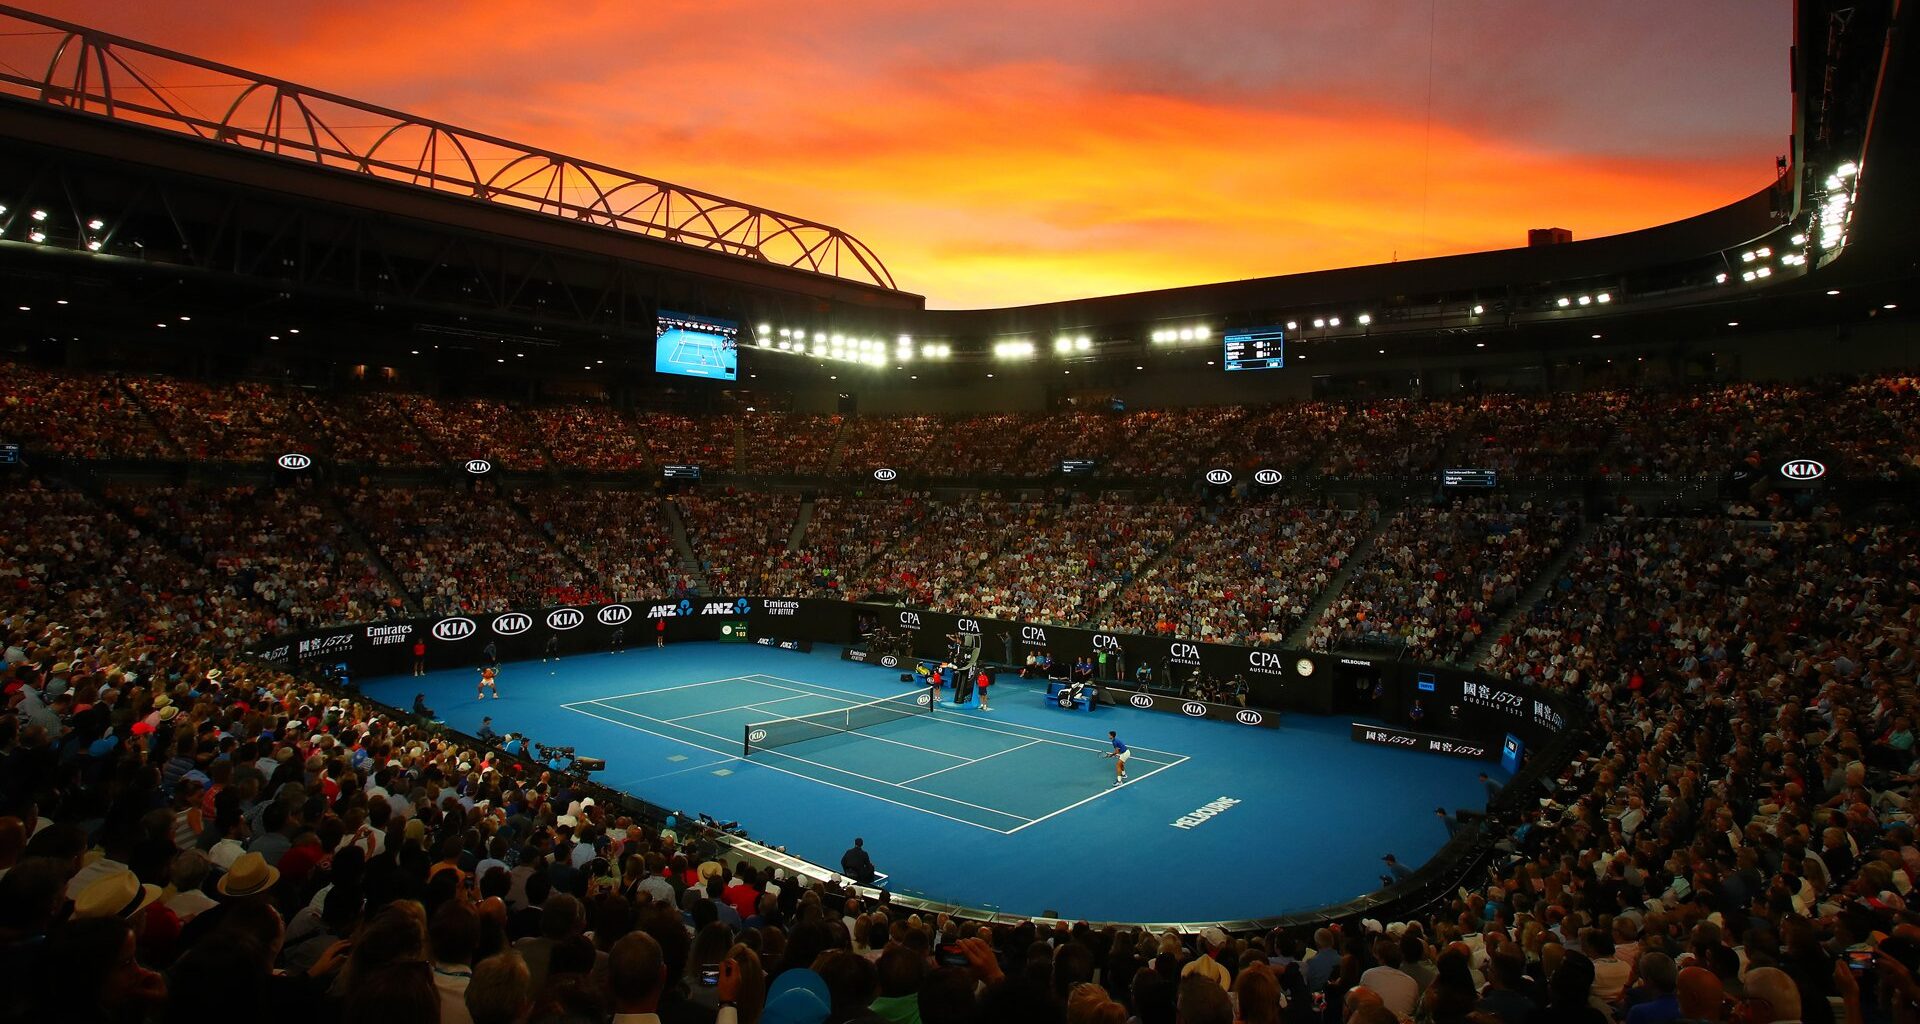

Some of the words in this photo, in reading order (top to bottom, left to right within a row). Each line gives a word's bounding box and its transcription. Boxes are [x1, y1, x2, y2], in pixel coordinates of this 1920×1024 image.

[284, 457, 305, 466] KIA
[470, 462, 486, 470] KIA
[1788, 464, 1818, 476] KIA
[1210, 472, 1228, 481] KIA
[1259, 472, 1278, 481] KIA
[701, 603, 734, 615] ANZ
[764, 599, 799, 609] Emirates
[603, 608, 626, 622] KIA
[647, 604, 677, 618] ANZ
[499, 617, 526, 631] KIA
[553, 613, 578, 626] KIA
[900, 611, 920, 625] CPA
[367, 624, 412, 637] Emirates
[440, 622, 469, 636] KIA
[958, 618, 980, 632] CPA
[1022, 626, 1046, 641] CPA
[373, 636, 383, 646] FLY
[384, 634, 406, 644] BETTER
[1093, 634, 1119, 649] CPA
[1170, 643, 1200, 659] CPA
[1170, 658, 1201, 666] AUSTRALIA
[1249, 651, 1282, 668] CPA
[1341, 658, 1370, 666] MELBOURNE
[1249, 667, 1282, 676] AUSTRALIA
[1134, 697, 1149, 705] KIA
[1463, 696, 1500, 710] GUOJIAO
[1186, 704, 1202, 714] KIA
[1240, 712, 1257, 722] KIA
[1169, 796, 1242, 830] MELBOURNE
